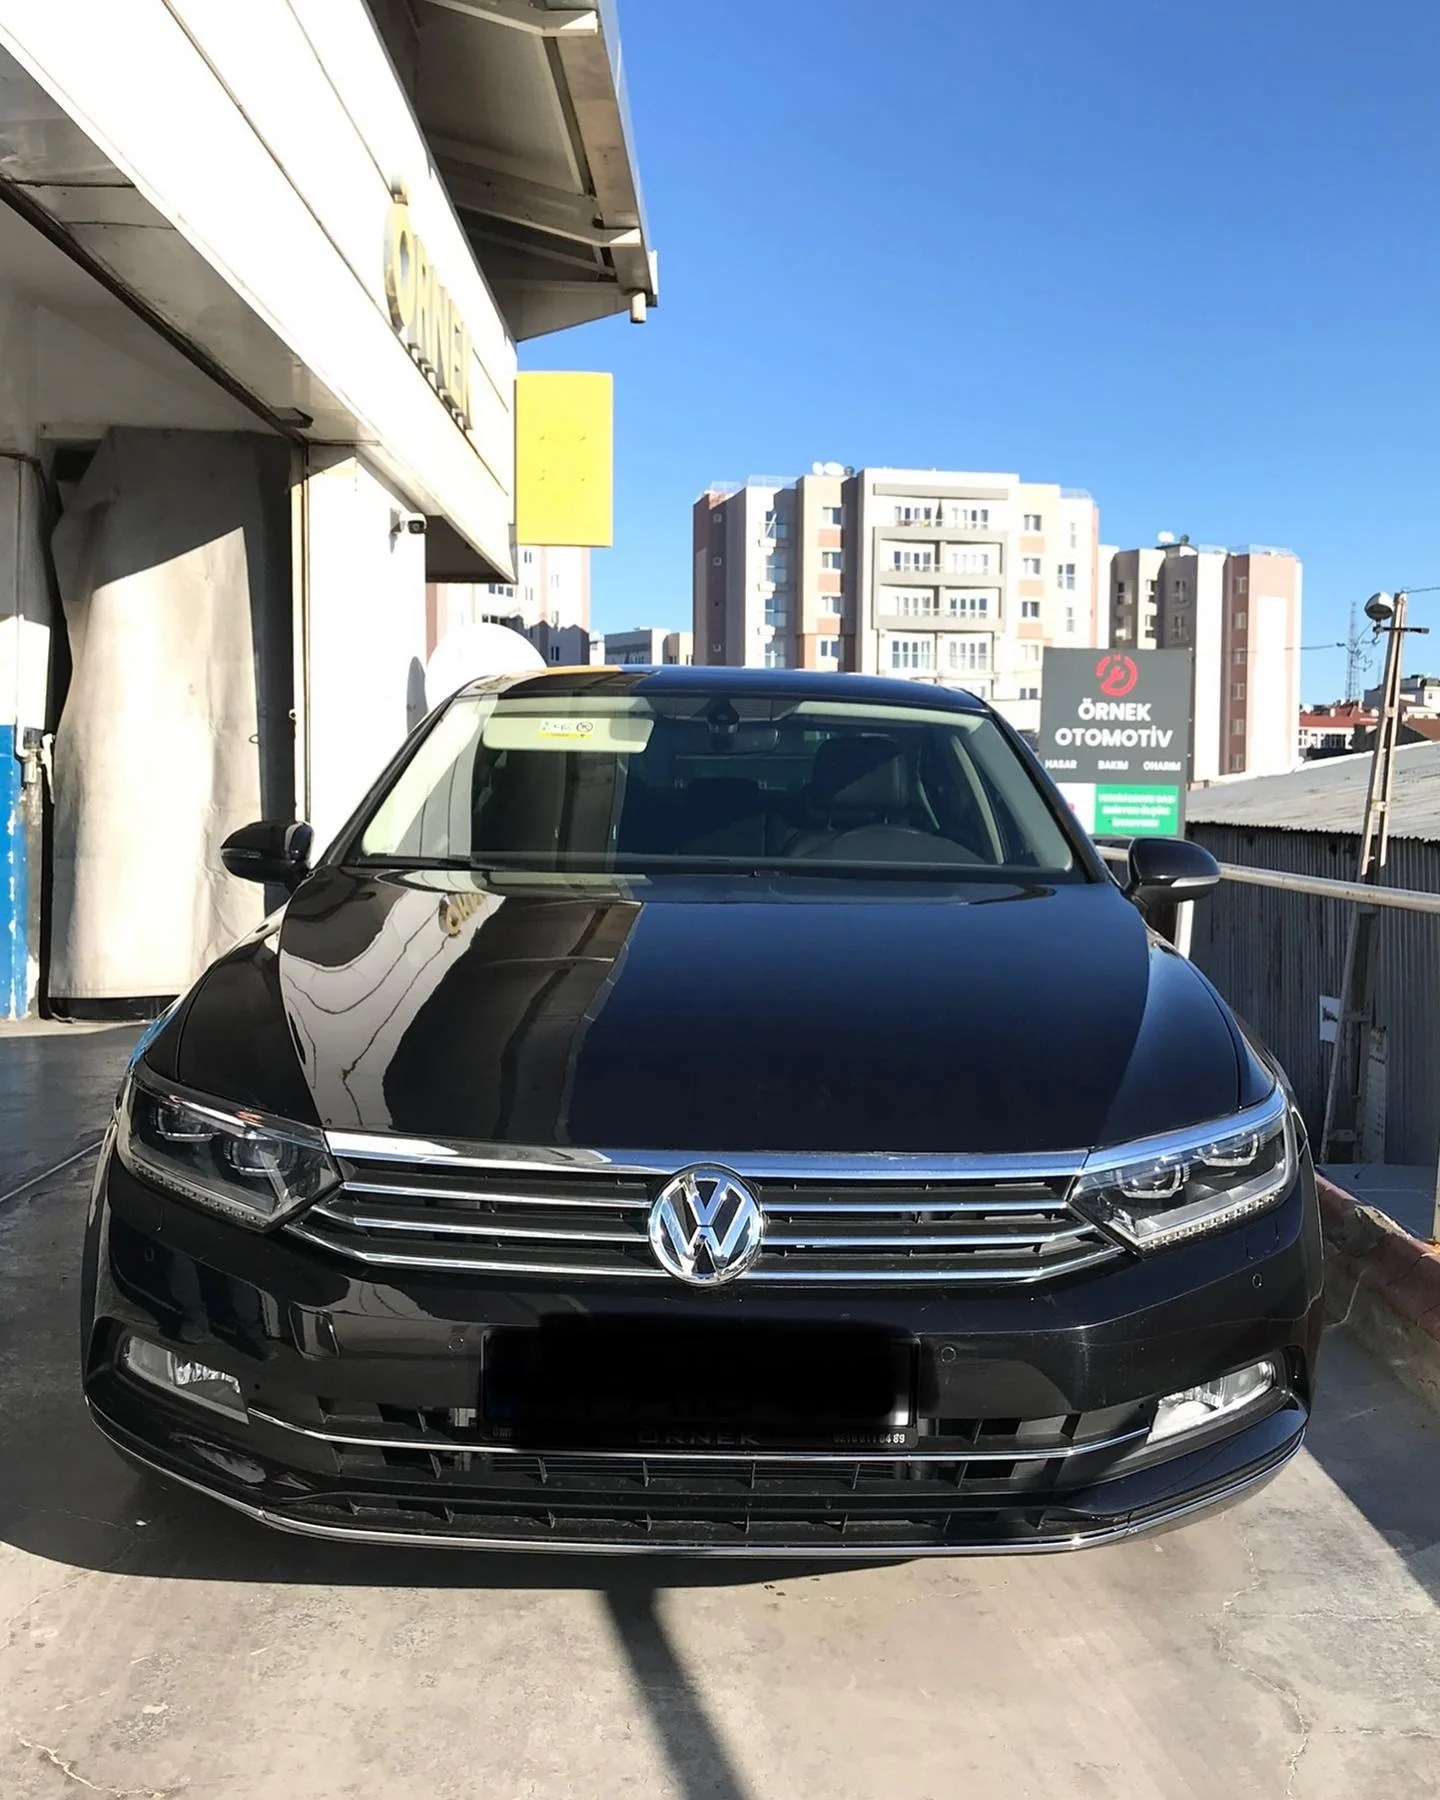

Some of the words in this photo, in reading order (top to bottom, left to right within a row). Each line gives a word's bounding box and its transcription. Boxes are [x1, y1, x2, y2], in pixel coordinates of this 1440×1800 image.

[1078, 698, 1152, 721] ÖRNEK
[1055, 725, 1173, 748] OTOMOTİV
[1045, 759, 1078, 769] HASAR
[1097, 760, 1129, 770] BAKIM
